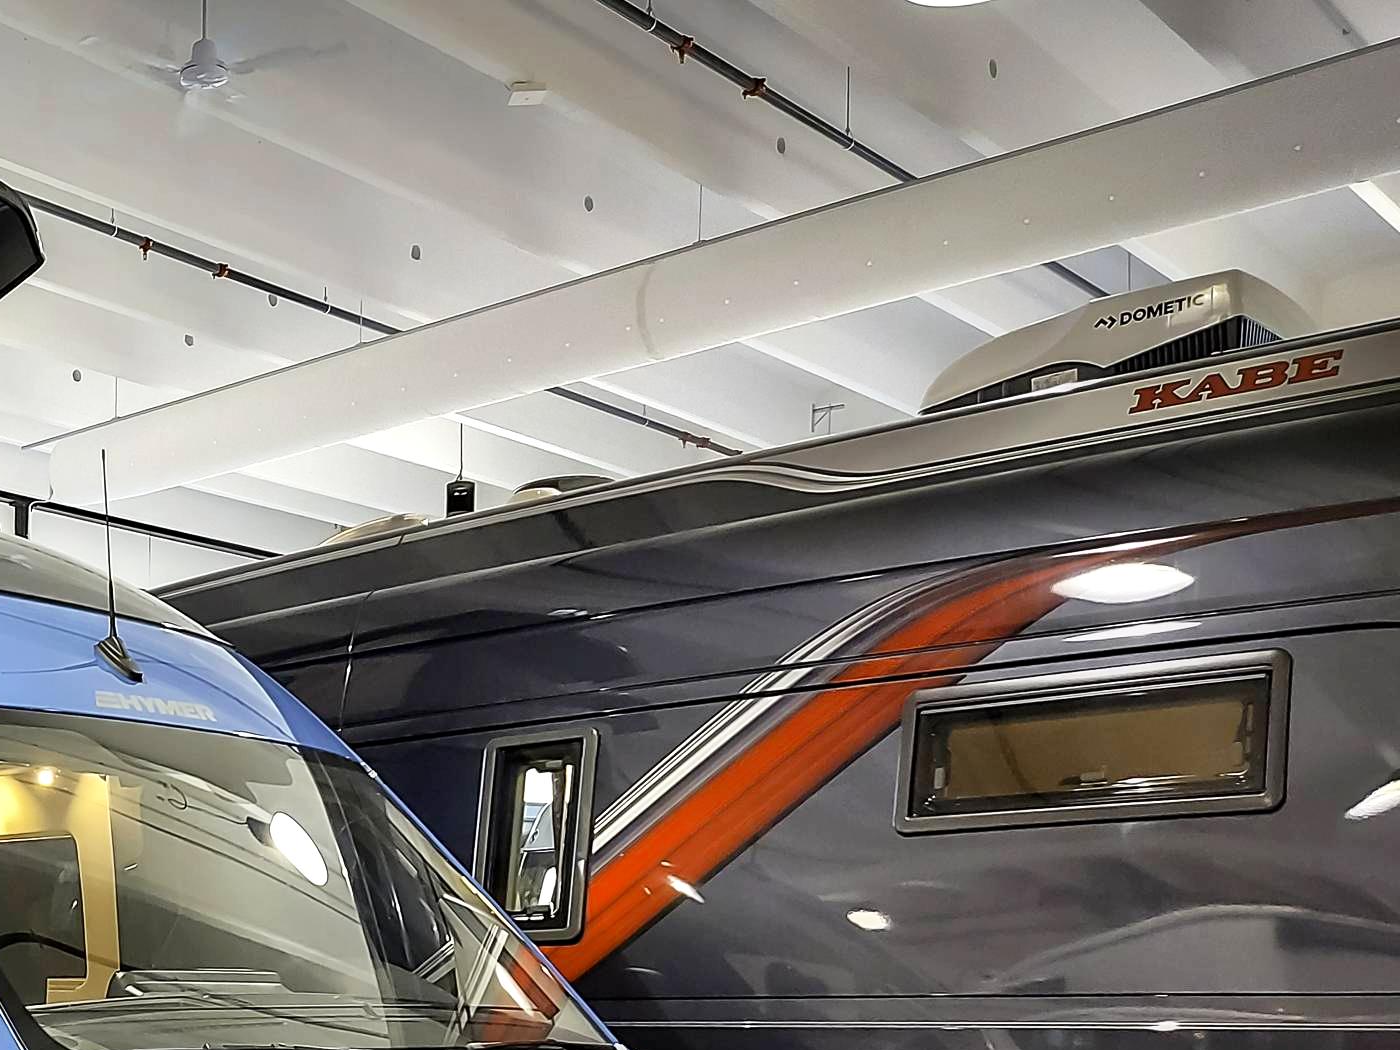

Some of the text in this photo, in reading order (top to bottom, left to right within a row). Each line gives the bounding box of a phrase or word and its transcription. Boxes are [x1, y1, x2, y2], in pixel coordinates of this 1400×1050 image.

[1120, 294, 1205, 326] DOMETIC
[1128, 349, 1344, 414] KABE
[121, 694, 218, 722] HYMER
